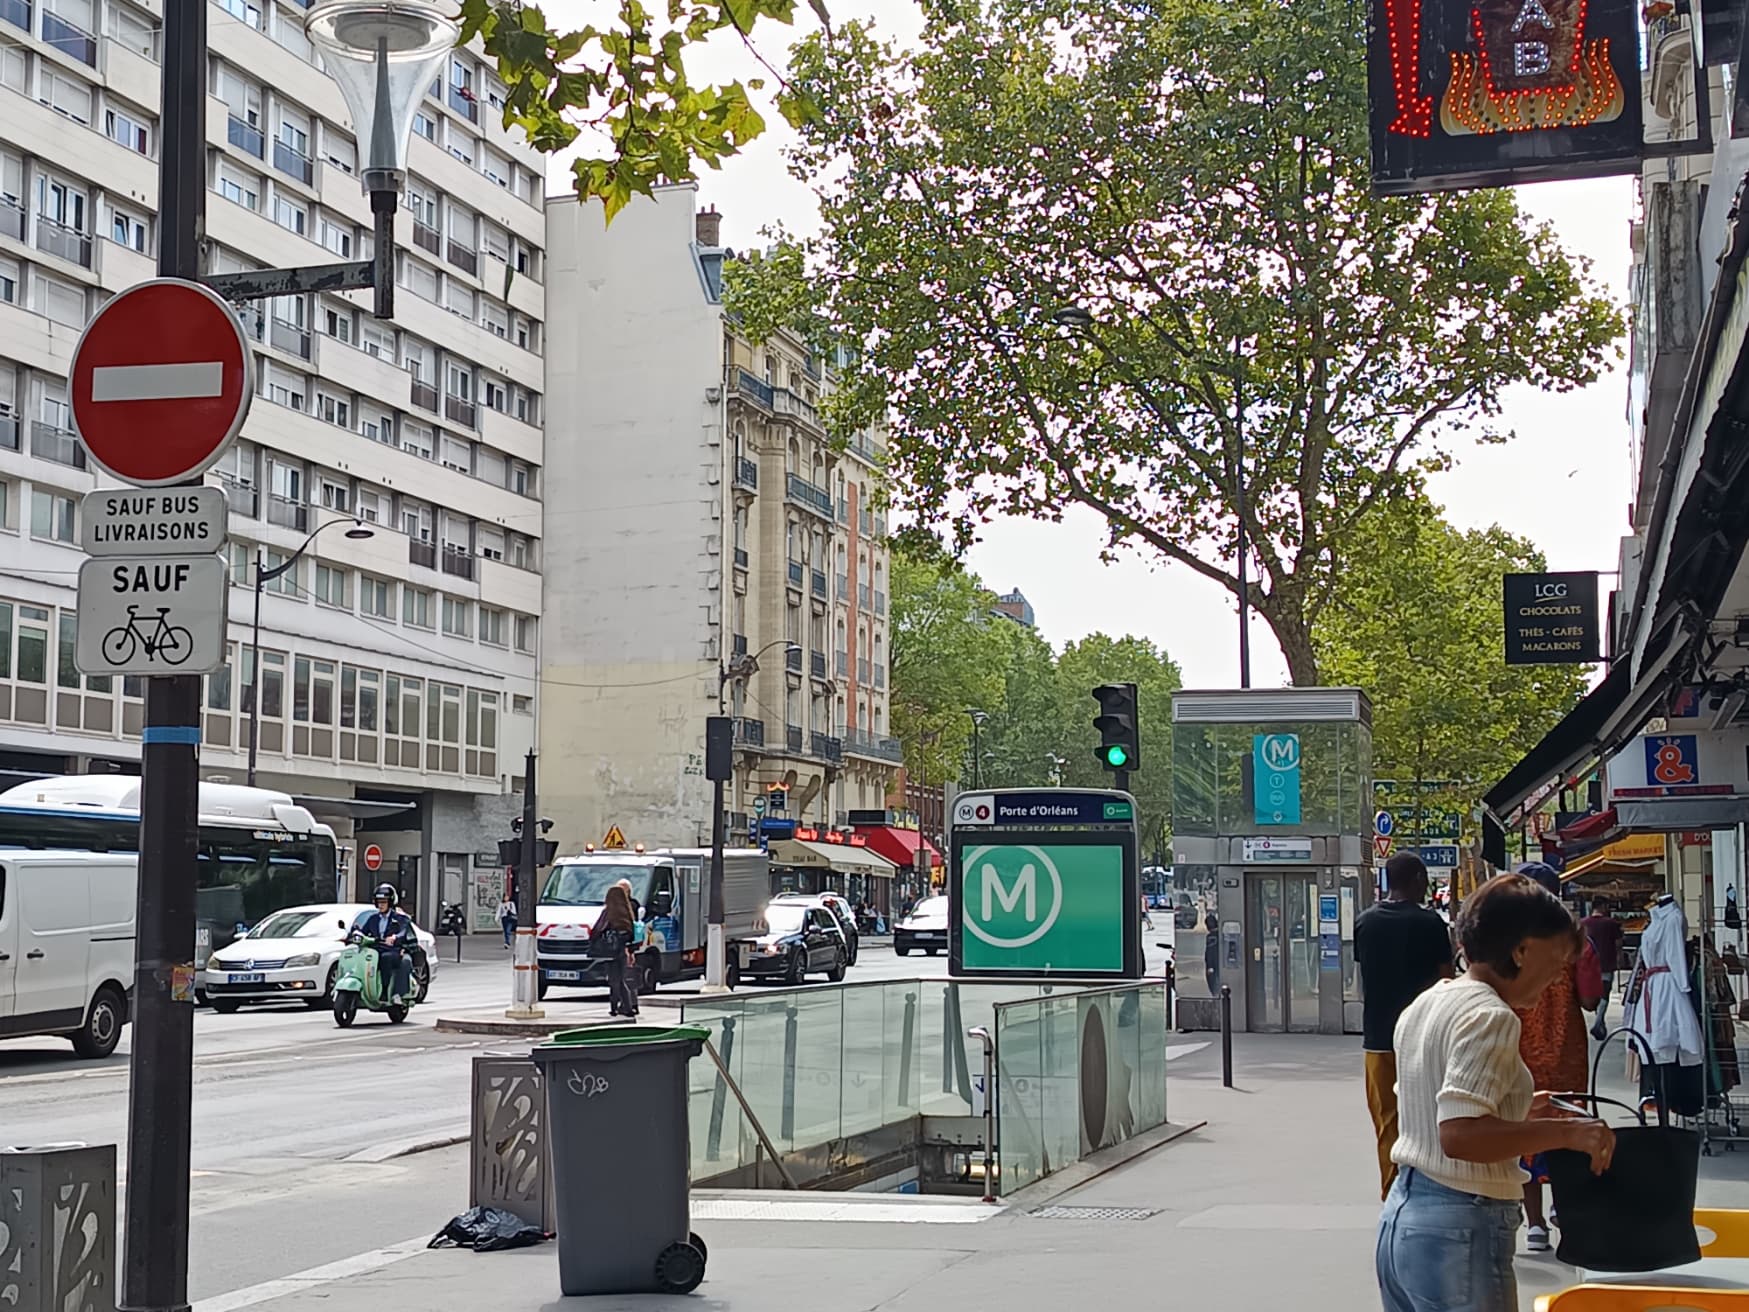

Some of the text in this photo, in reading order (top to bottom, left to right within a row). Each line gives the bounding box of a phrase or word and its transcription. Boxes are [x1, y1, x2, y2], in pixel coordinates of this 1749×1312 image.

[106, 496, 199, 516] SAUF BUS
[95, 521, 209, 542] LIVRAISONS
[113, 564, 190, 593] SAUF
[1535, 583, 1568, 597] LCG
[1519, 605, 1582, 616] CHOCOLATS
[1519, 627, 1545, 637] THÉS
[1552, 626, 1584, 637] CAFÉS
[1522, 641, 1582, 652] MACARONS
[999, 806, 1027, 817] Porte
[1029, 805, 1079, 817] d'Orléans
[981, 863, 1037, 923] M
